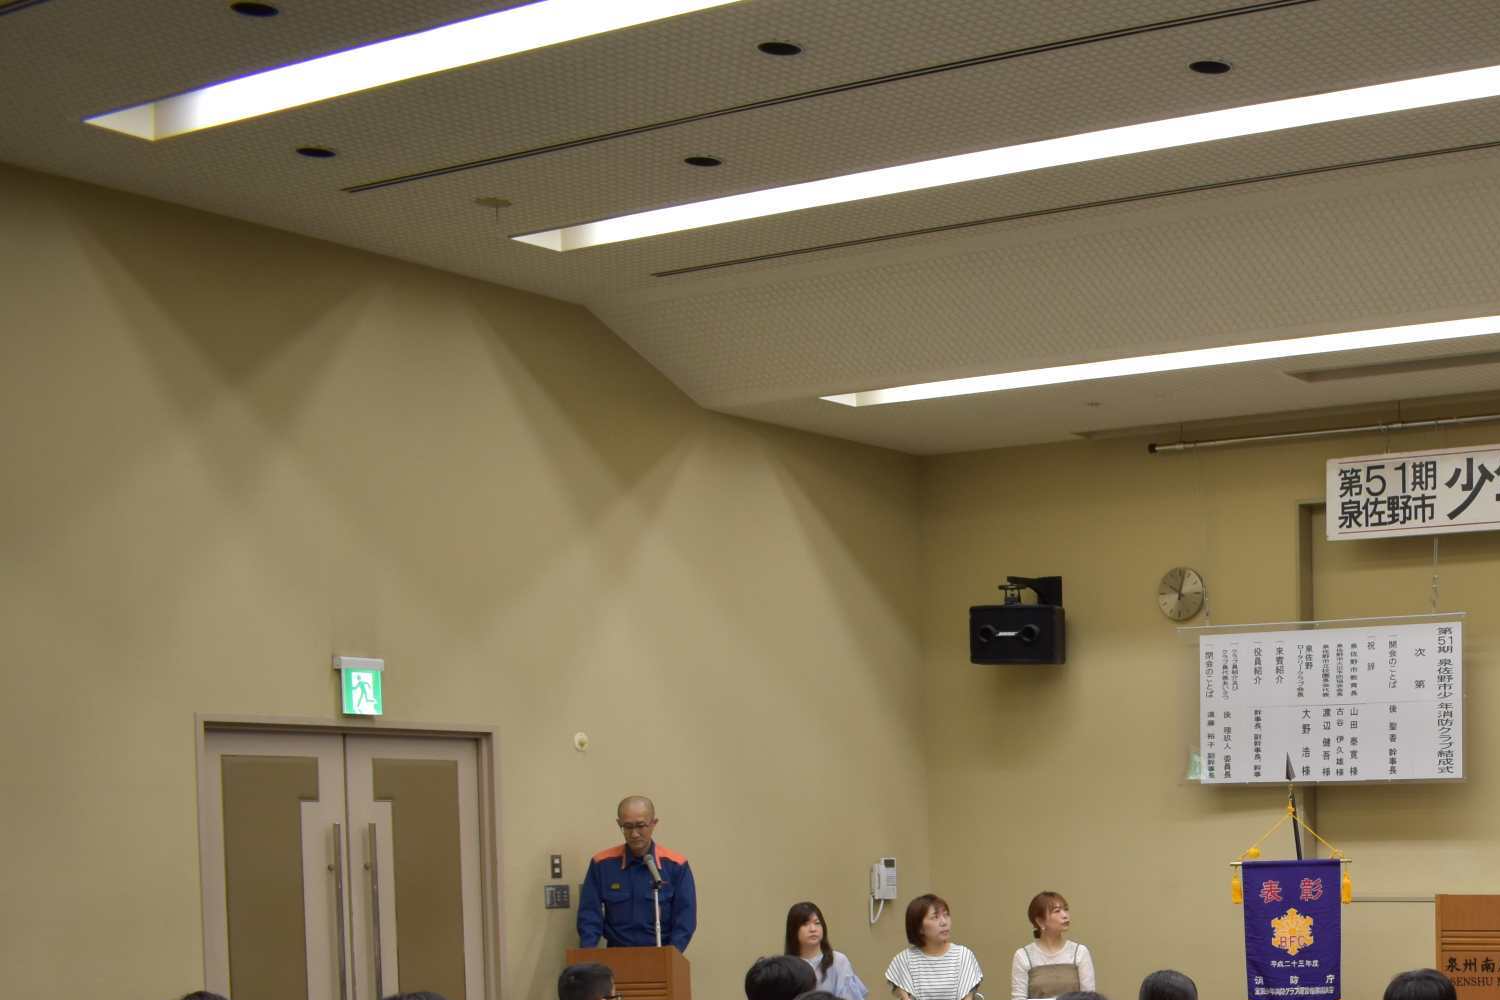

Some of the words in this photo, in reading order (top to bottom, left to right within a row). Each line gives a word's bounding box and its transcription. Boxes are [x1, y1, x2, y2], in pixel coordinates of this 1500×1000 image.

[1338, 460, 1437, 499] 第51期
[1338, 491, 1437, 530] 泉佐野市
[1259, 877, 1324, 904] 表彰
